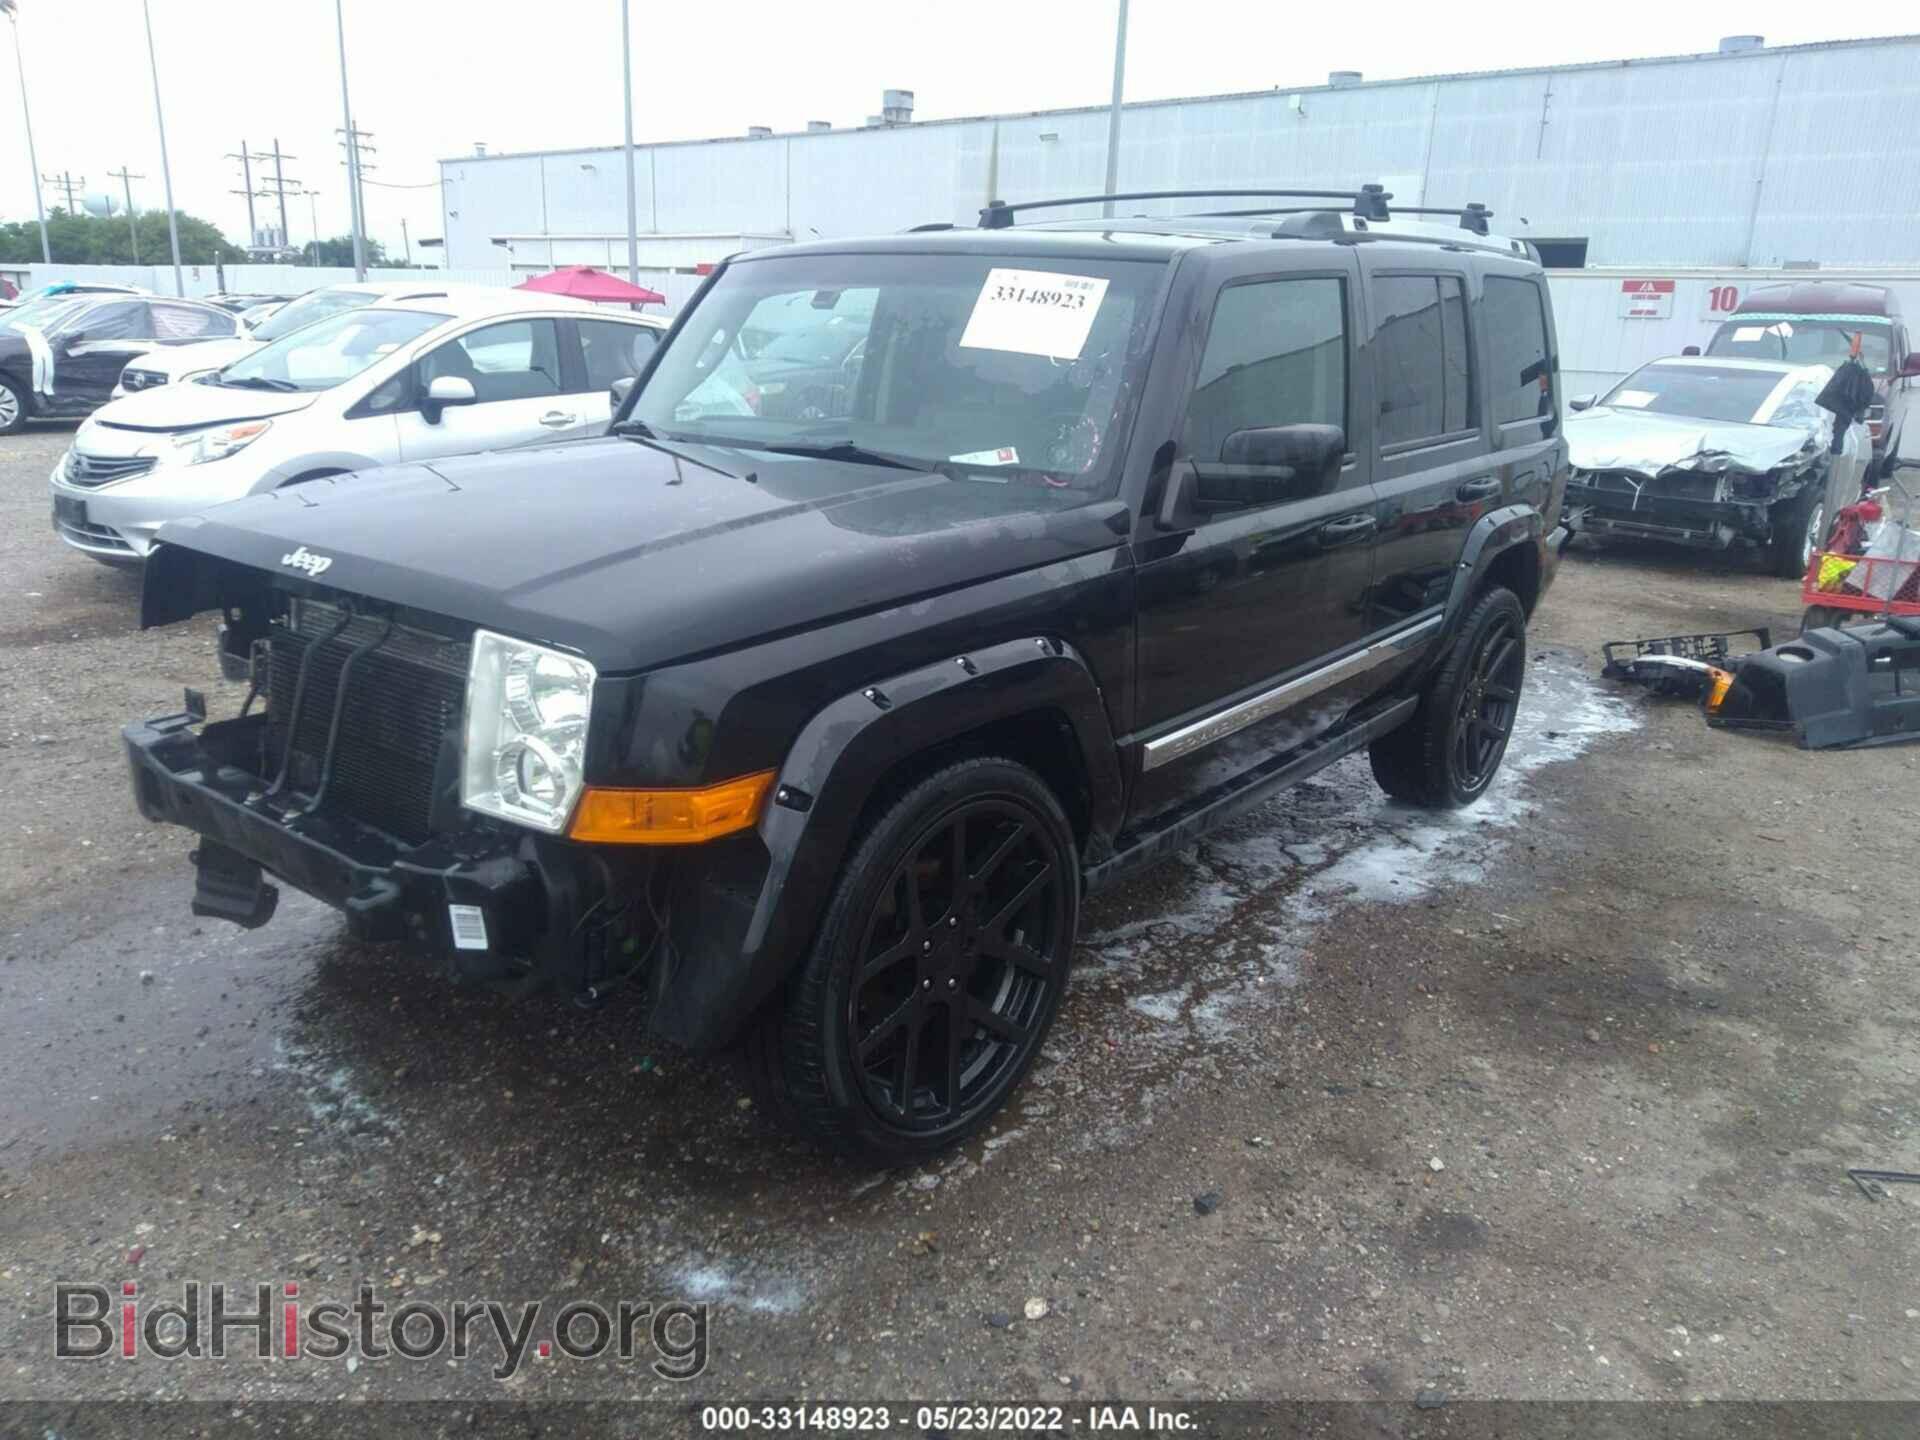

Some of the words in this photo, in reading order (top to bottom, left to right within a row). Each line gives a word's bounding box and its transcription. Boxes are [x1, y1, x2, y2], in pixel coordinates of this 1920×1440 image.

[990, 286, 1086, 309] 33148923
[1709, 286, 1738, 312] 10
[281, 546, 333, 576] Jeep
